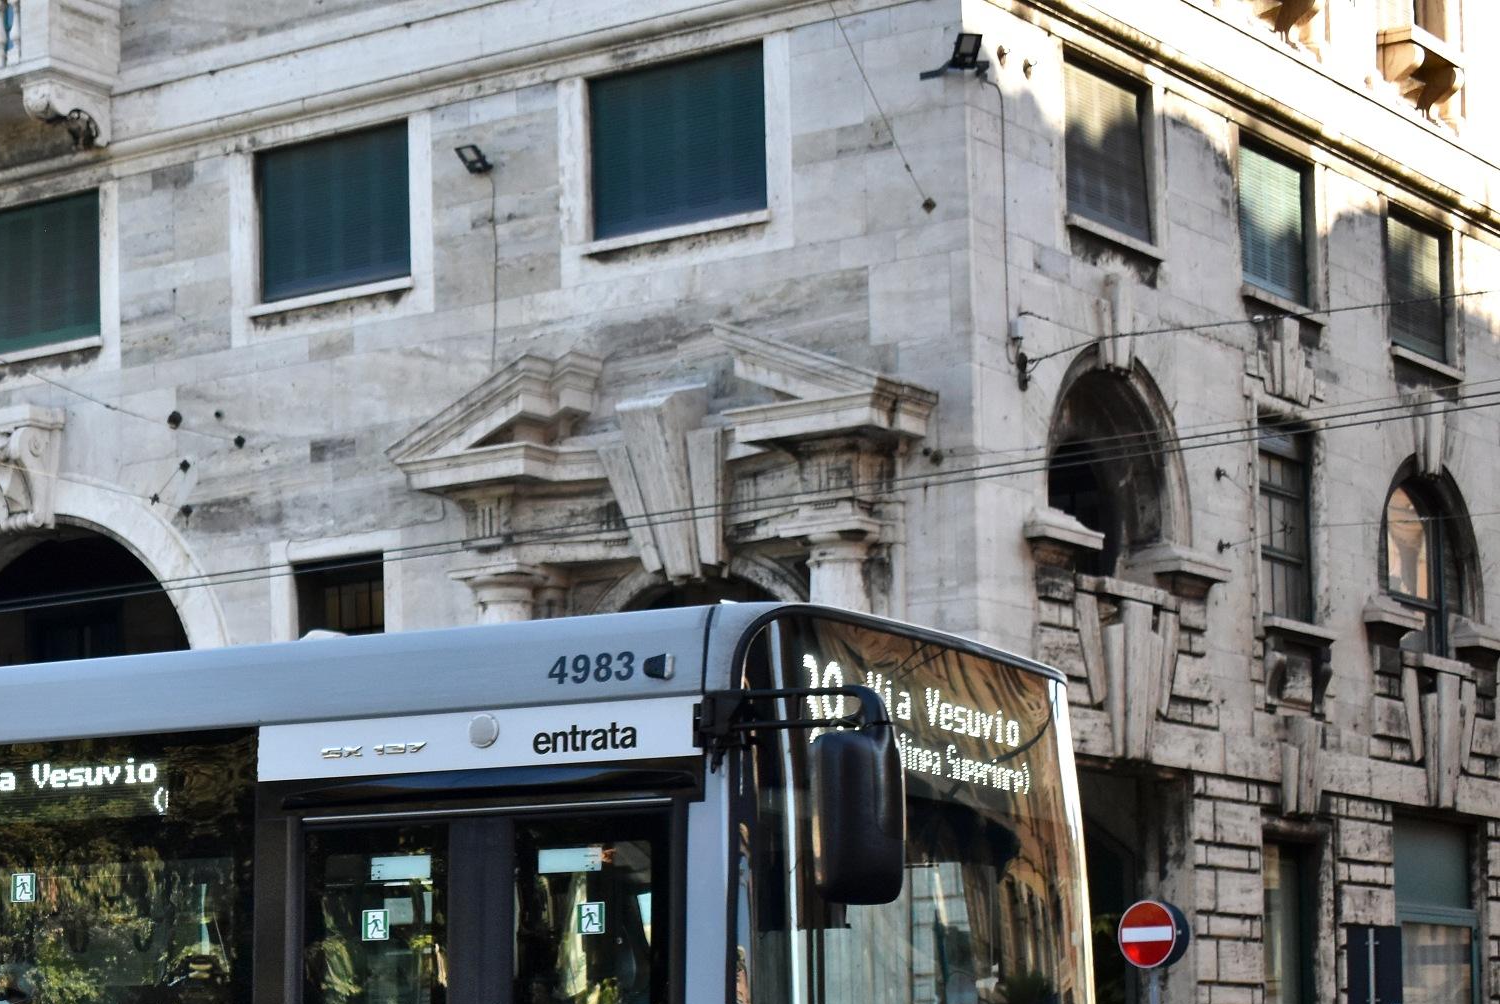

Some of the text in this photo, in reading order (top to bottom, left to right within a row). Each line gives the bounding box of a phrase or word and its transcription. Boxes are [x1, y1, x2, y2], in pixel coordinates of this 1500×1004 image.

[548, 651, 635, 684] 4983
[925, 687, 1020, 748] Vesuvio
[532, 722, 637, 755] entrata
[32, 757, 157, 789] Vesuvio
[946, 744, 1031, 795] Superiore)
